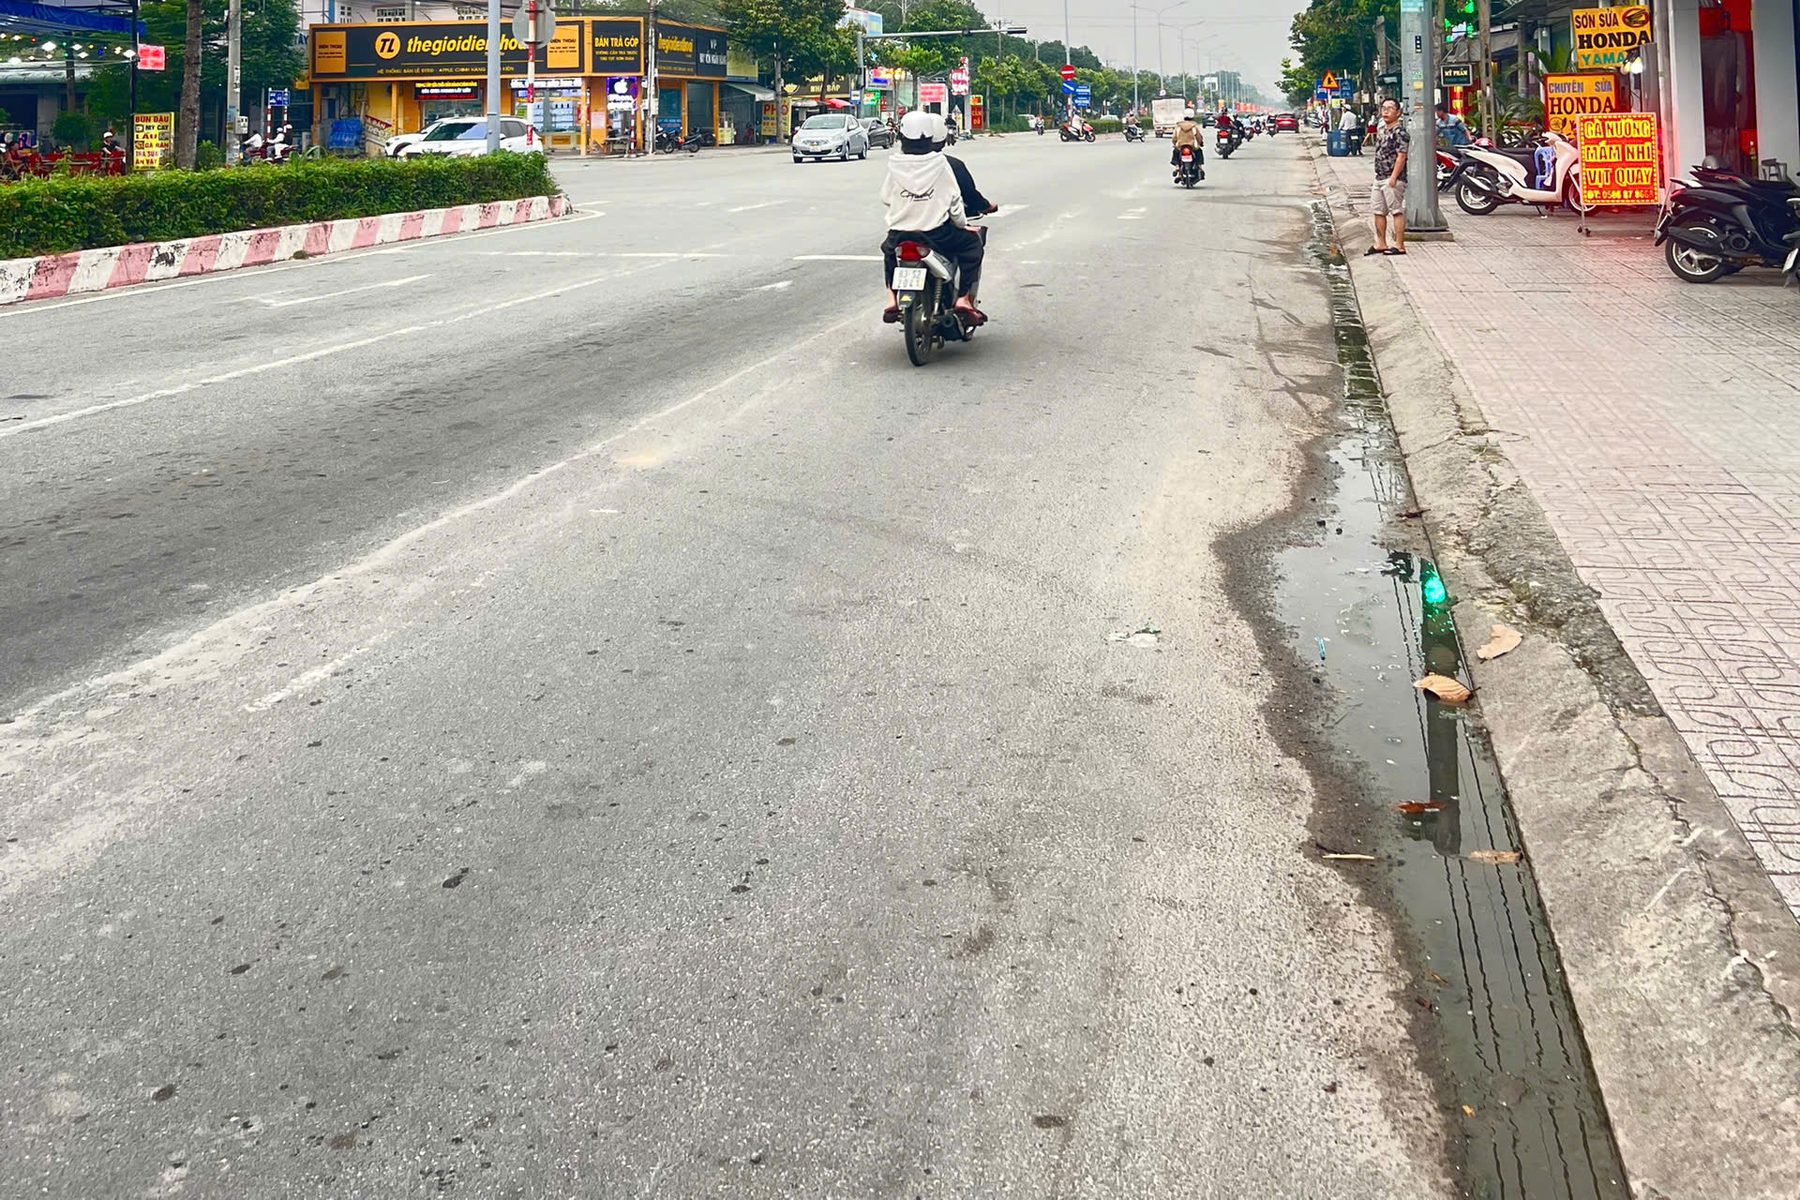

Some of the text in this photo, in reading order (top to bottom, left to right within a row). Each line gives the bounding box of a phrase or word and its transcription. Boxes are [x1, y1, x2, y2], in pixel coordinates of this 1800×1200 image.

[380, 38, 396, 53] TL
[1578, 30, 1652, 50] HONDA
[1548, 96, 1616, 115] HONDA
[1586, 168, 1652, 188] VỊT QUAY
